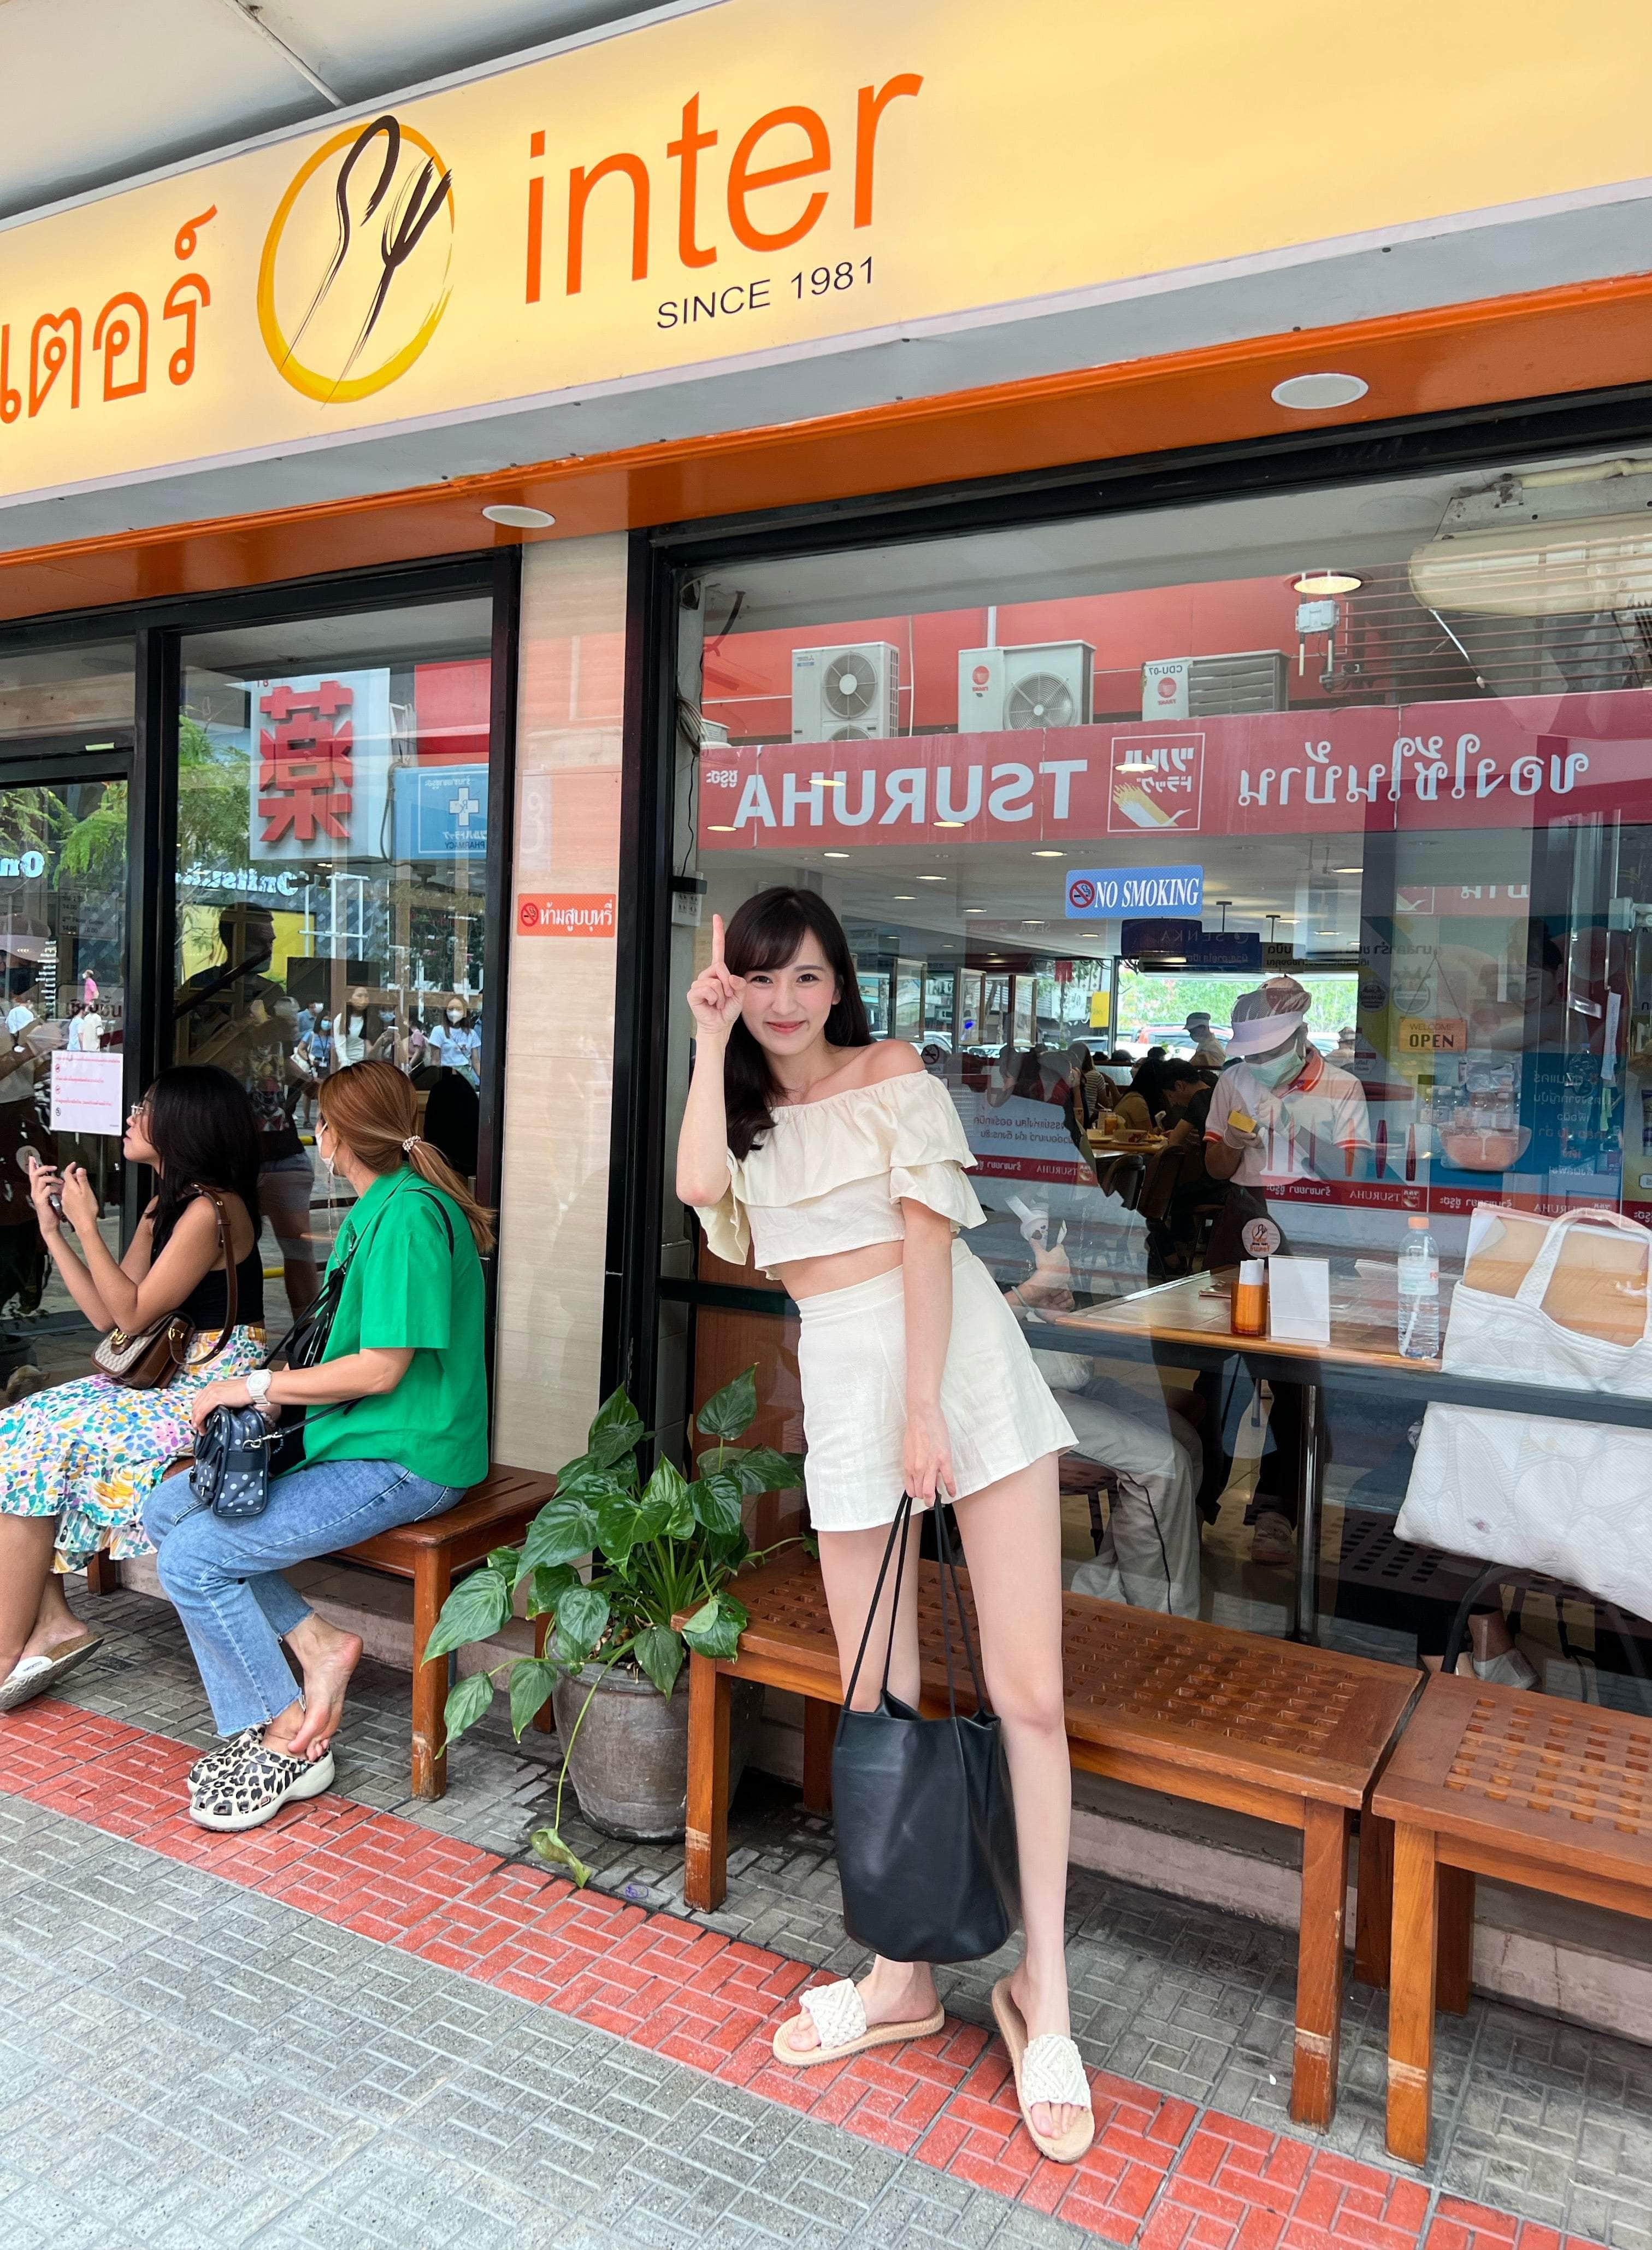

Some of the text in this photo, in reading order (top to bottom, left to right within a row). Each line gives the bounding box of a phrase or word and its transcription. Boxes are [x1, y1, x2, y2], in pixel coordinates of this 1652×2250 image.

[526, 73, 924, 304] inter
[657, 256, 874, 329] SINCE 1981
[1094, 877, 1200, 908] NO SMOKING
[1409, 1034, 1454, 1048] OPEN
